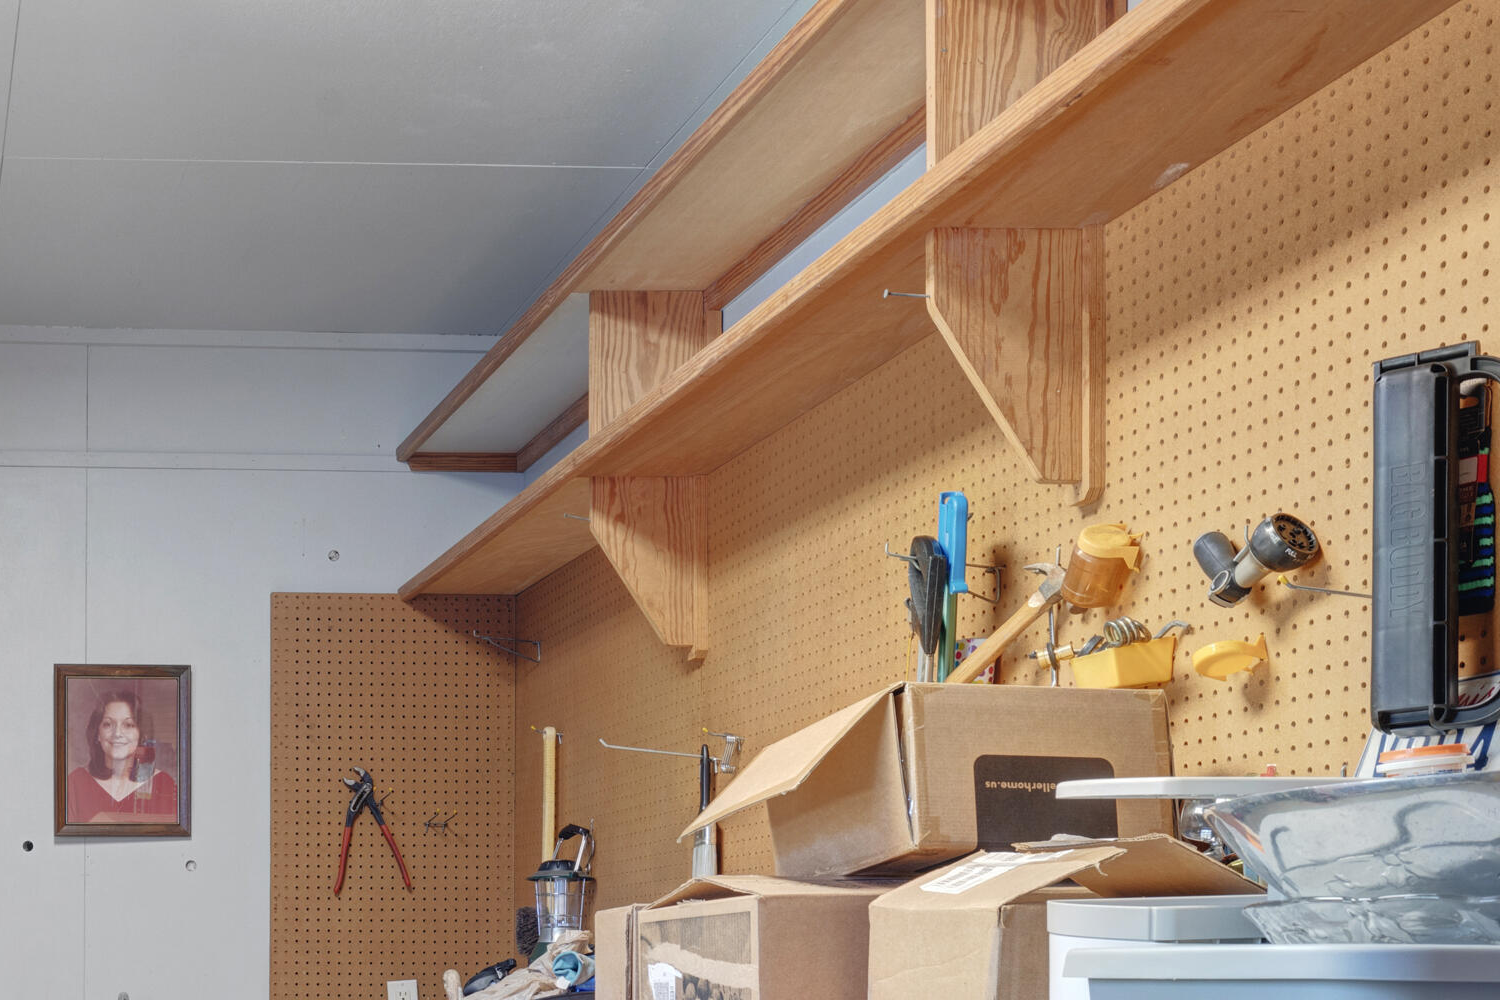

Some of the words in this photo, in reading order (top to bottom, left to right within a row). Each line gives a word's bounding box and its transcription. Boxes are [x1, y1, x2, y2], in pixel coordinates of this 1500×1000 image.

[1390, 462, 1428, 521] BAG
[1389, 526, 1428, 619] BUDDY
[985, 781, 1056, 792] ellerhome.us
